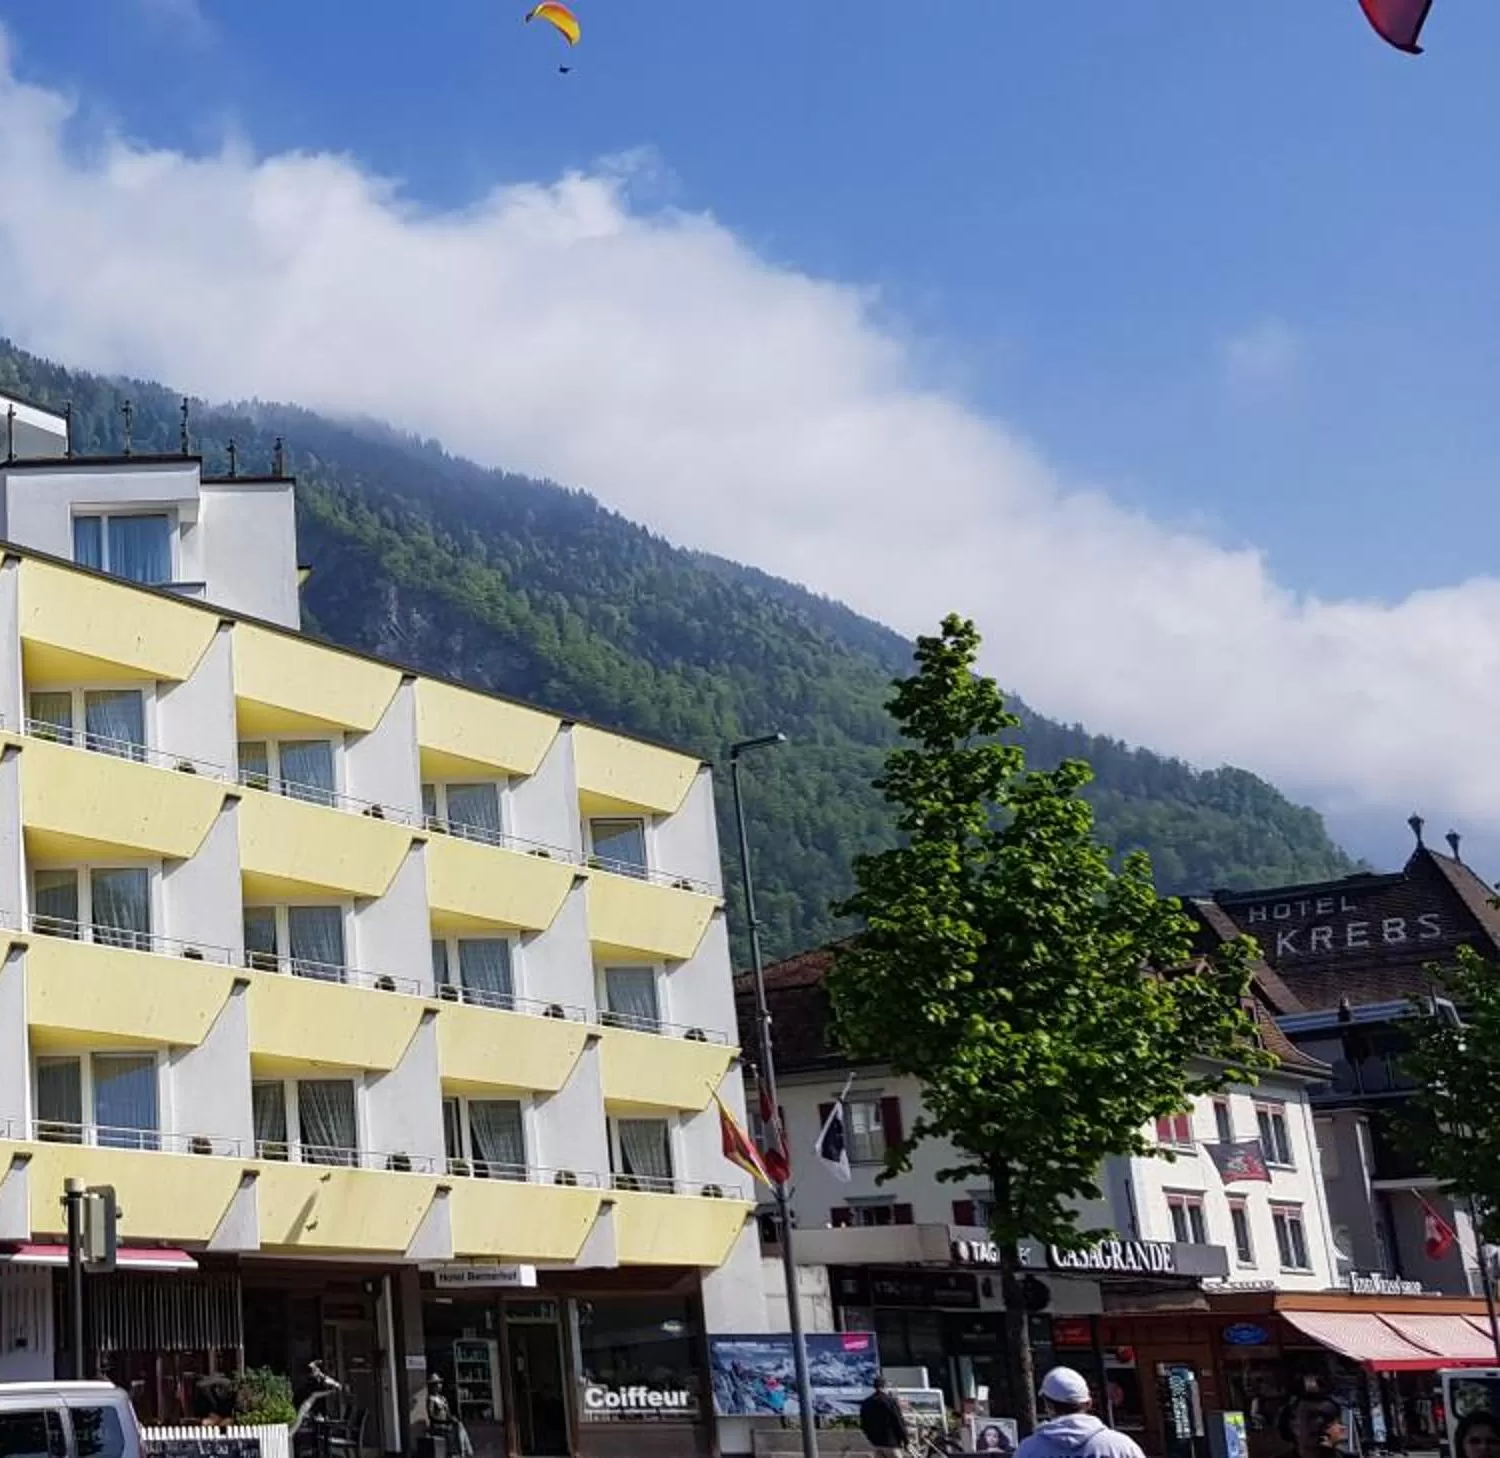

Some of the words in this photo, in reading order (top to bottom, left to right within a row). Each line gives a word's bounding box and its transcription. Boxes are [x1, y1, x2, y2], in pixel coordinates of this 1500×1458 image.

[1249, 896, 1357, 923] HOTEL
[1276, 913, 1442, 956] KREBS
[971, 1240, 998, 1263] TAG
[1051, 1239, 1176, 1272] CASAGRANDE
[585, 1386, 690, 1408] Coiffeur
